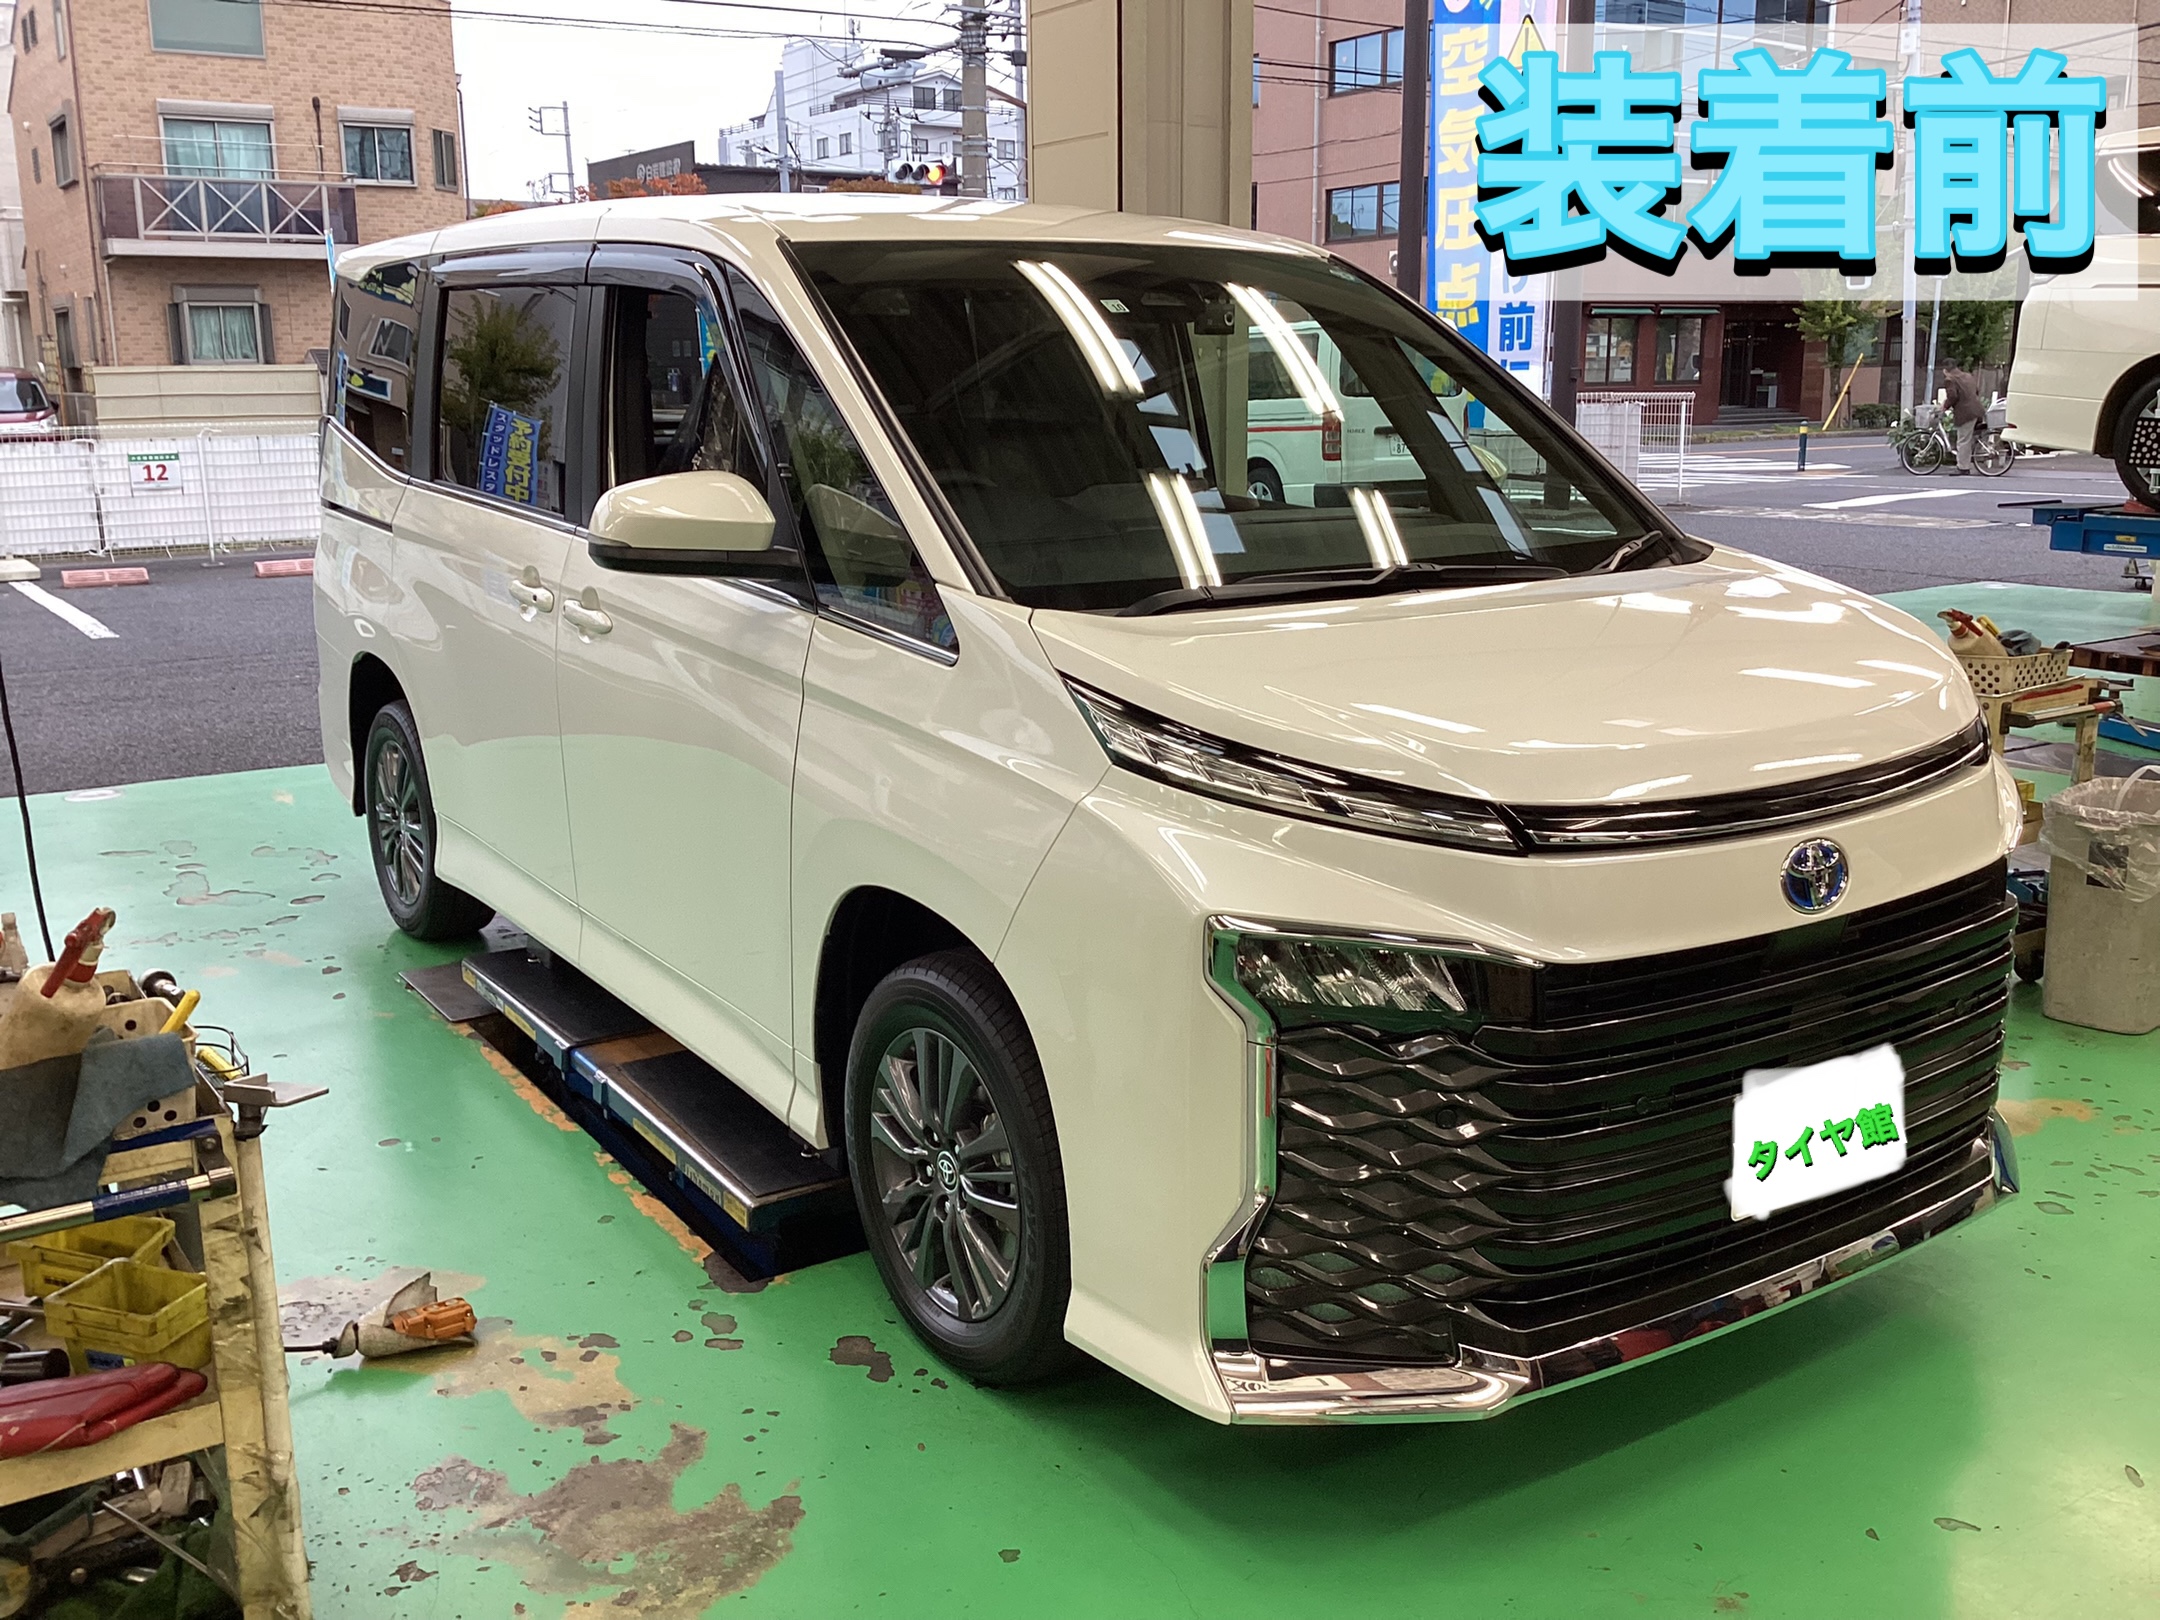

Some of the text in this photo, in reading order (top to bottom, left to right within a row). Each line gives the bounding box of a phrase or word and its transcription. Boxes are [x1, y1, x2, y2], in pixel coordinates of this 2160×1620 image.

[142, 463, 169, 482] 12
[485, 412, 508, 492] スタッドレスタ
[504, 417, 534, 502] 予約受付中
